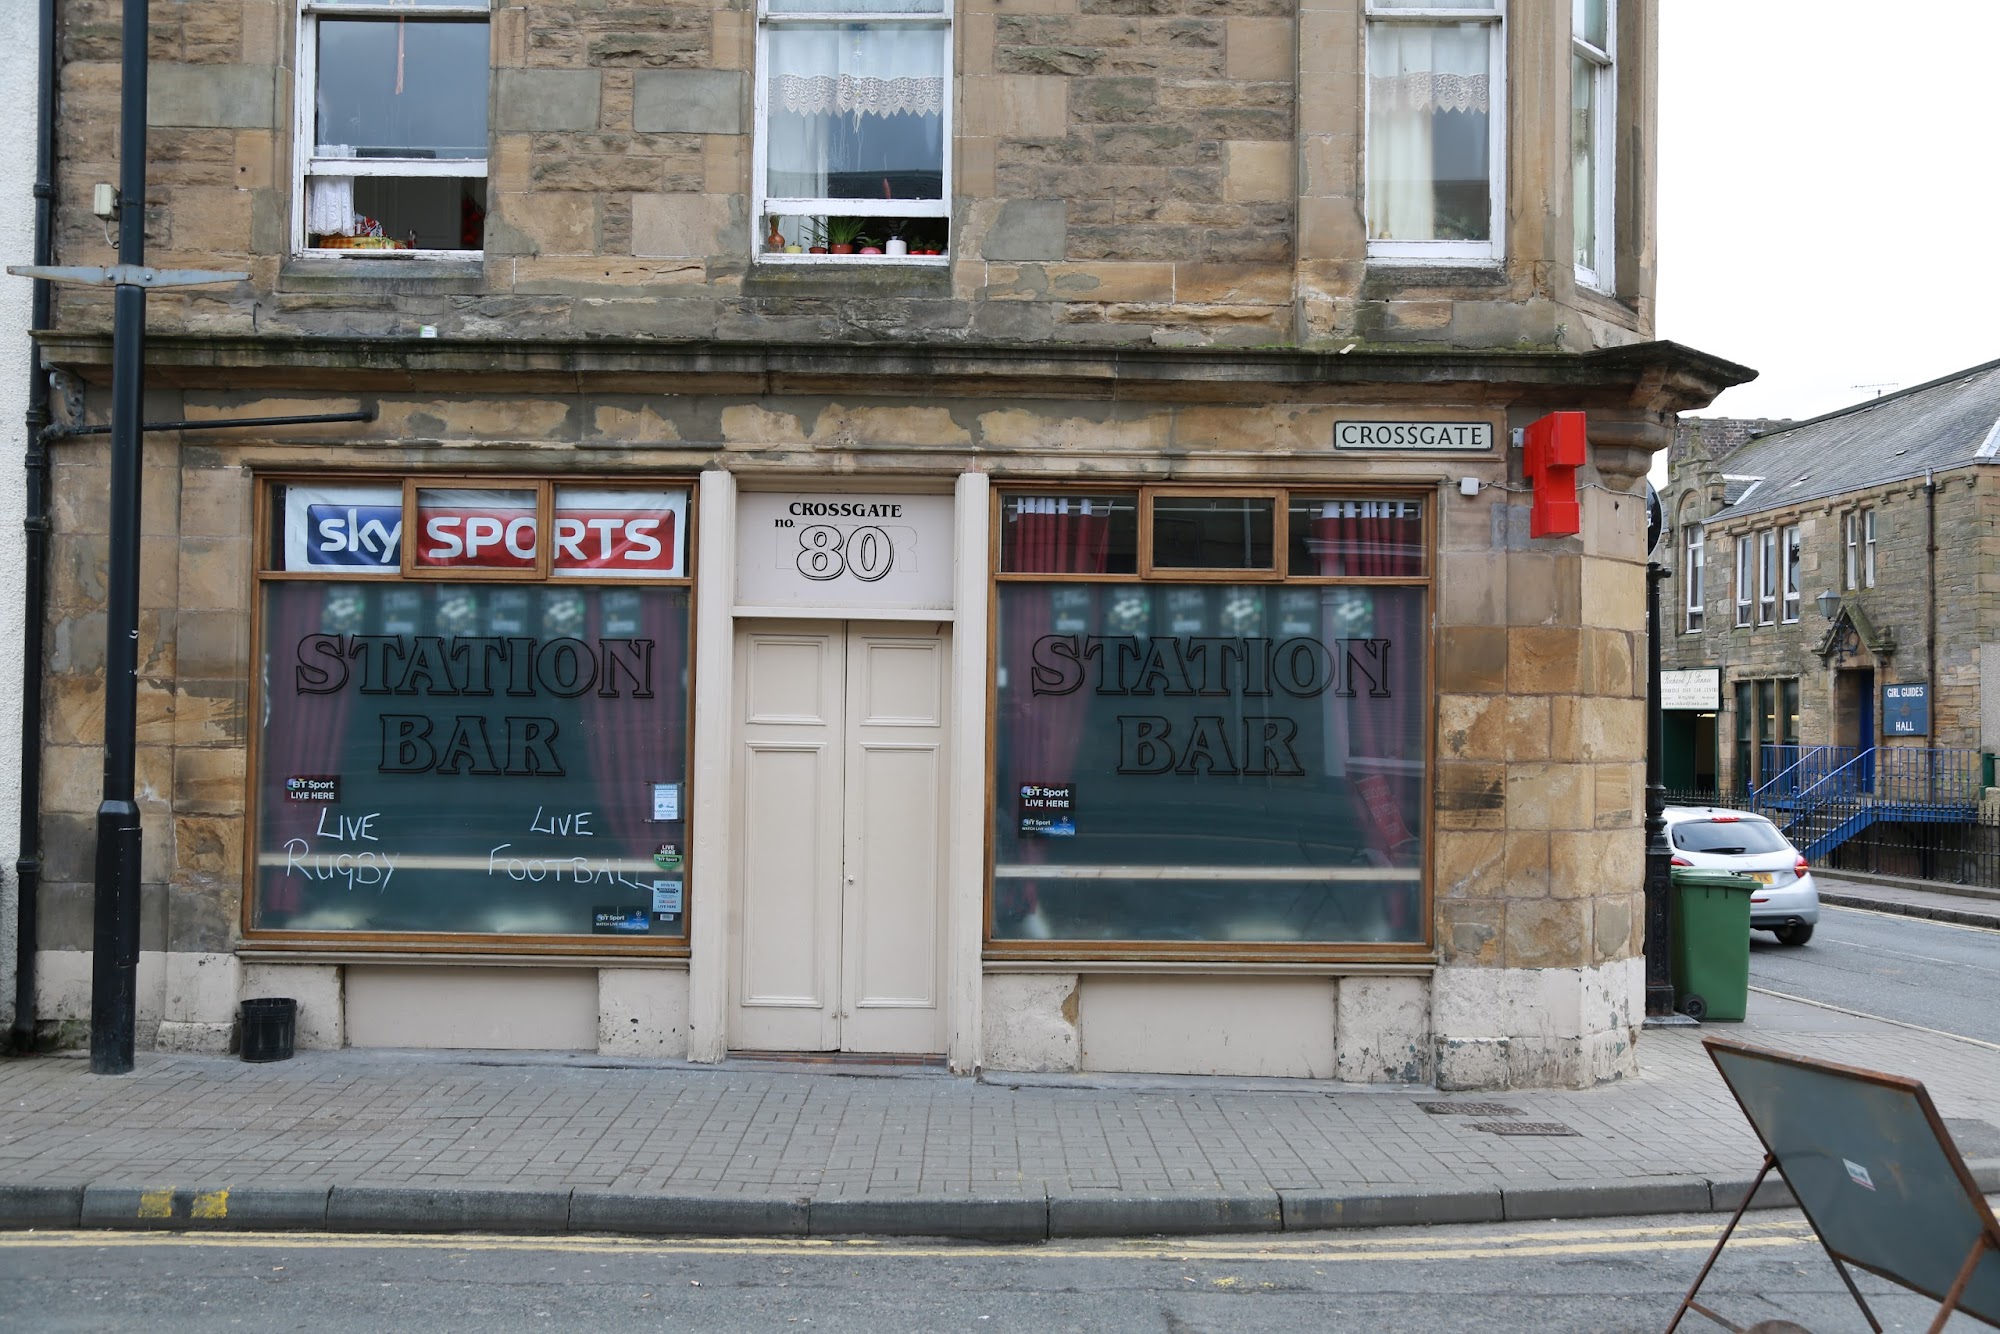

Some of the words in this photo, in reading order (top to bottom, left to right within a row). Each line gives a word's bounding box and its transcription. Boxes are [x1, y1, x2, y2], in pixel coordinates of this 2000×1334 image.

[1342, 426, 1482, 445] CROSSGATE
[789, 502, 902, 518] CROSSGATE
[774, 518, 796, 528] no.
[319, 509, 402, 564] sky
[426, 516, 662, 561] SPORTS
[796, 524, 895, 583] 80
[296, 633, 655, 699] STATION
[1031, 634, 1391, 699] STATION
[1887, 688, 1900, 697] GIRL
[1901, 687, 1924, 697] GUIDES
[1895, 721, 1914, 731] HALL
[378, 713, 565, 776] BAR
[1116, 715, 1305, 777] BAR
[292, 780, 307, 789] BT
[308, 780, 334, 790] Sport
[311, 792, 335, 800] HERE
[1026, 788, 1042, 797] BT
[1043, 788, 1069, 798] Sport
[1025, 799, 1043, 807] LIVE
[1046, 800, 1069, 808] HERE
[316, 807, 380, 841] LIVE
[530, 806, 593, 836] LIVE
[488, 843, 658, 892] FOOTBALL
